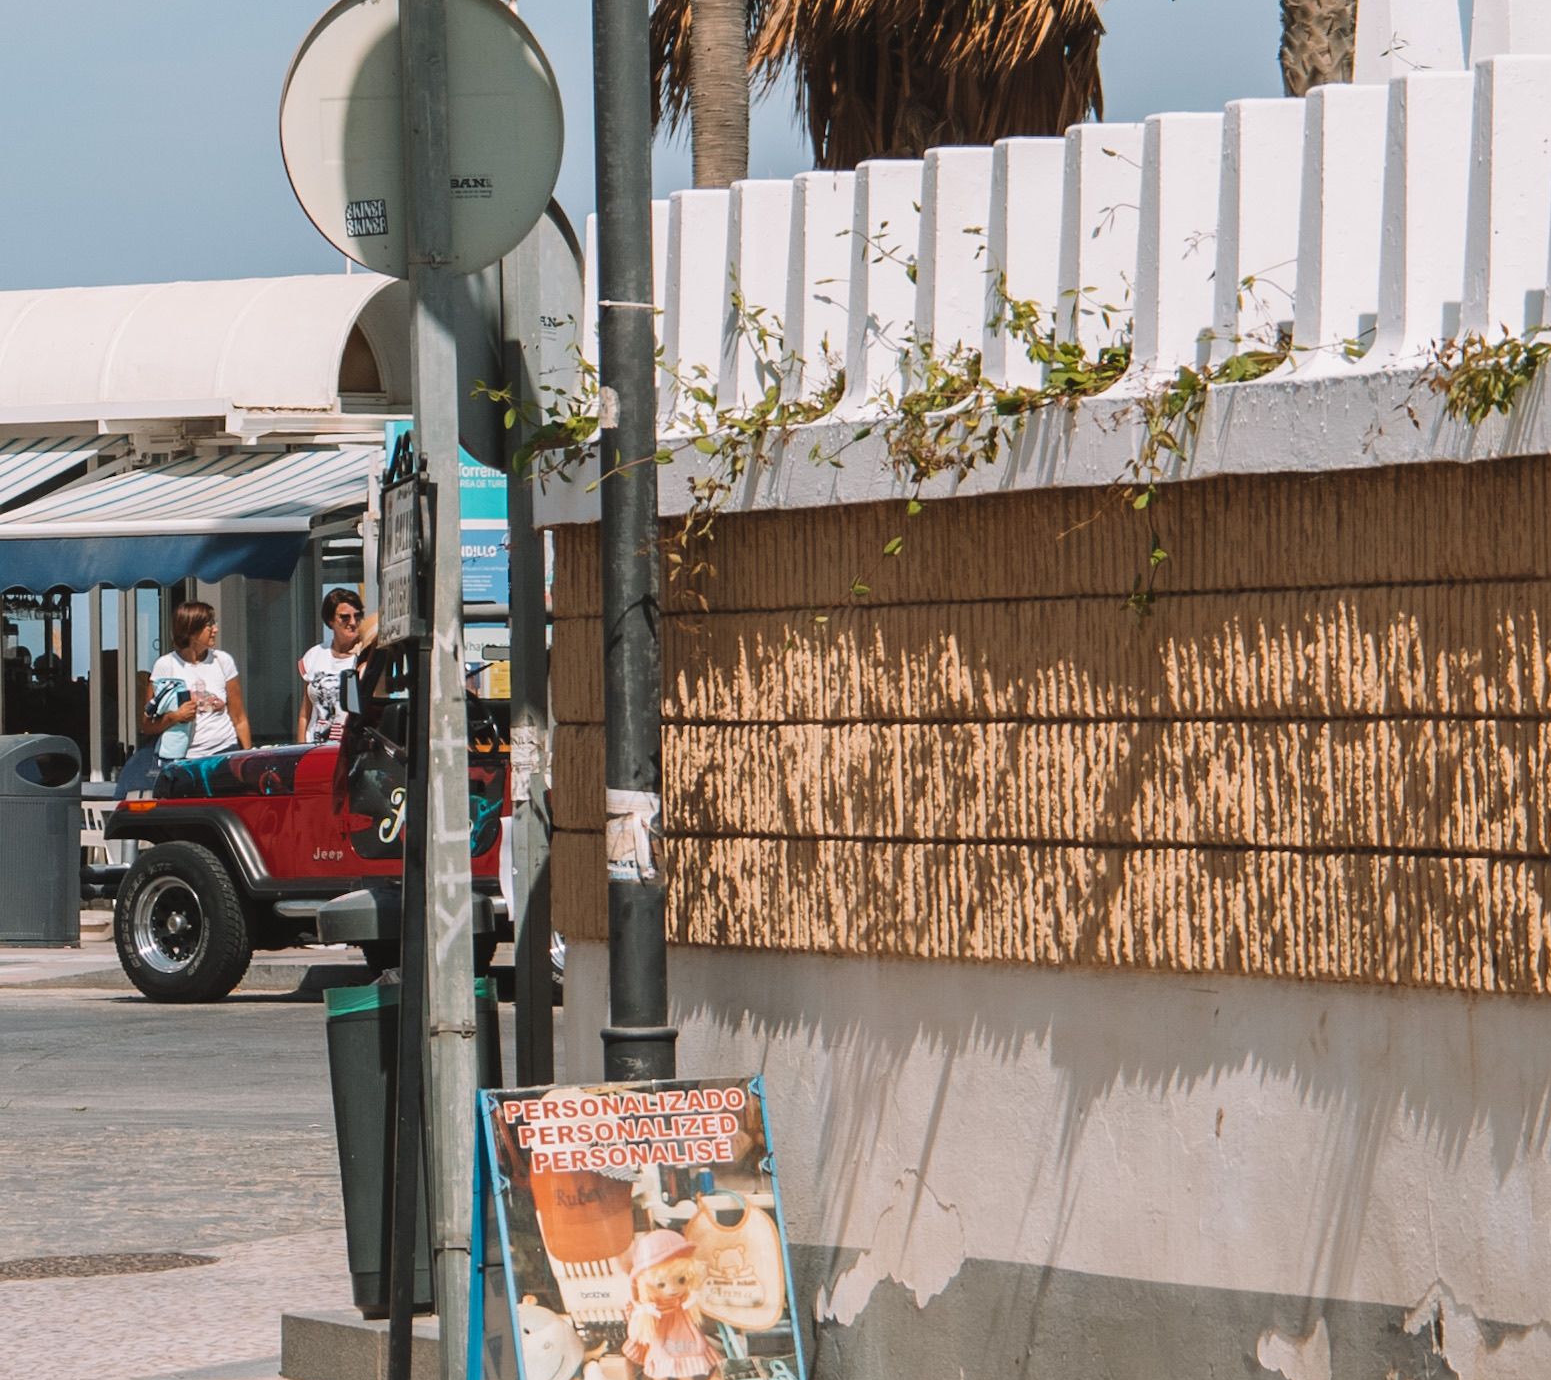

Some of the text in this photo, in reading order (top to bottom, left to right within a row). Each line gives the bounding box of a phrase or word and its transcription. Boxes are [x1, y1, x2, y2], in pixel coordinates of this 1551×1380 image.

[313, 847, 344, 861] Jeep
[503, 1087, 746, 1123] PERSONALIZADO
[518, 1113, 738, 1149] PERSONALIZED
